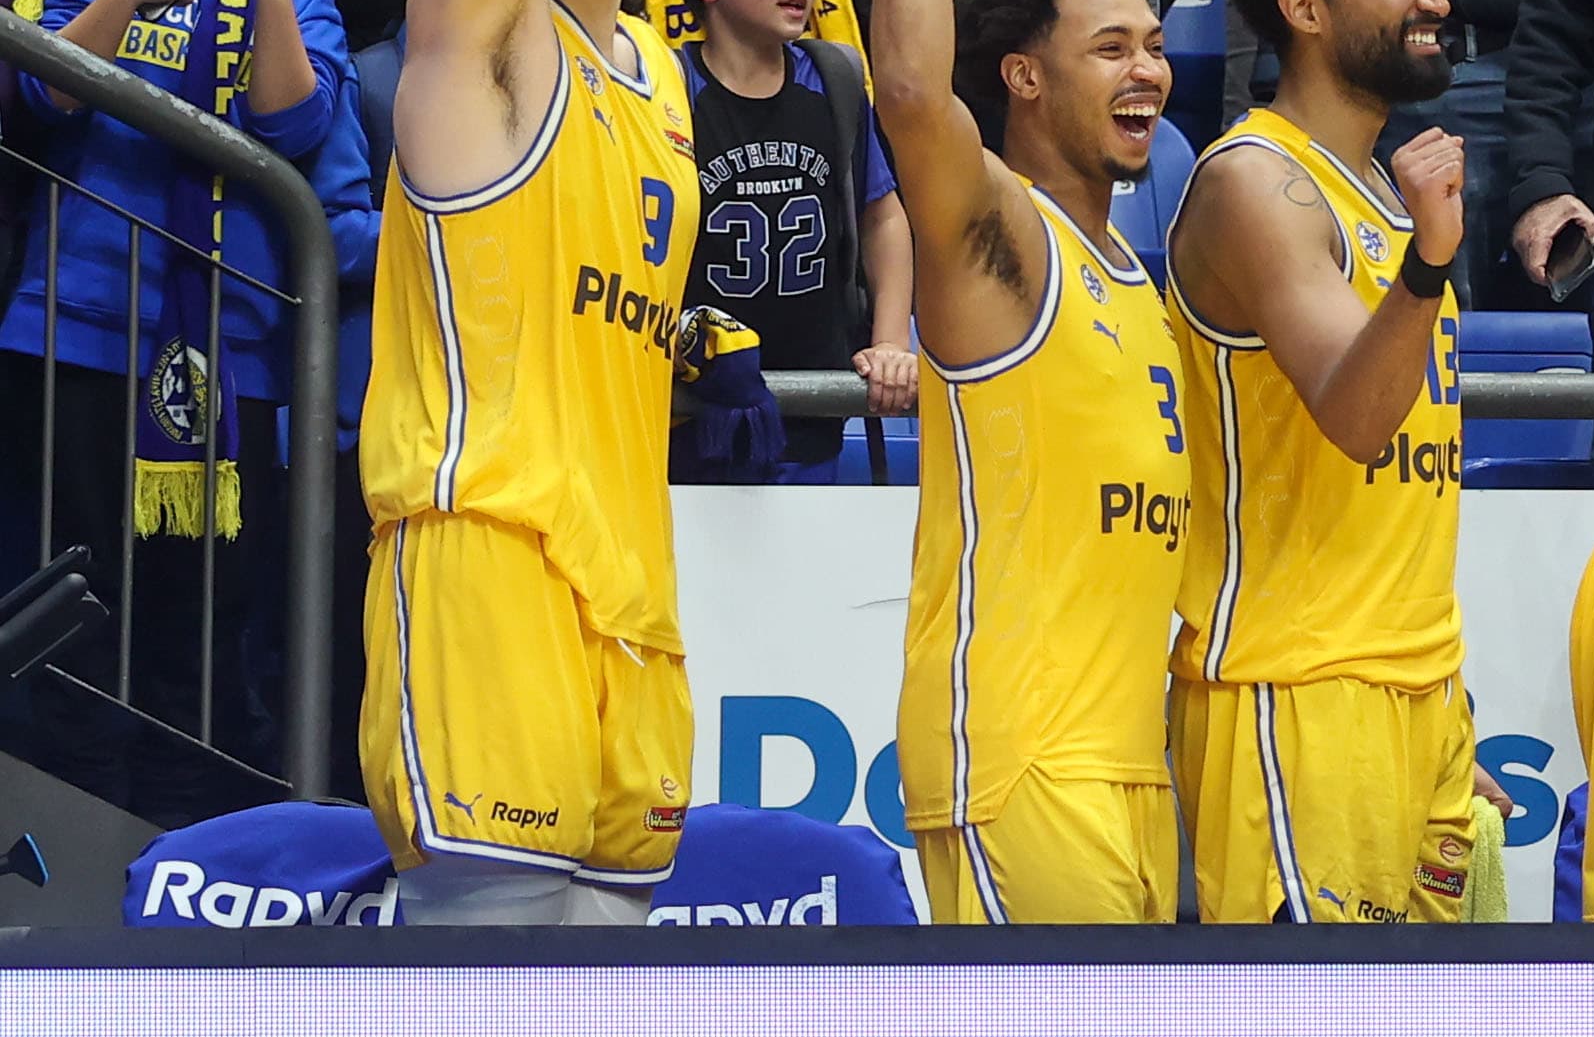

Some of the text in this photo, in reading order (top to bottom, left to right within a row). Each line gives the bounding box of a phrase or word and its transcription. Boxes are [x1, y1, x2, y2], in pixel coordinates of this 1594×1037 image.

[699, 141, 831, 195] AUTHENTIC
[736, 177, 803, 195] BROOKLYN
[640, 176, 676, 268] 9
[706, 194, 827, 298] 32
[1148, 364, 1185, 455] 3
[490, 801, 560, 828] Rapyd
